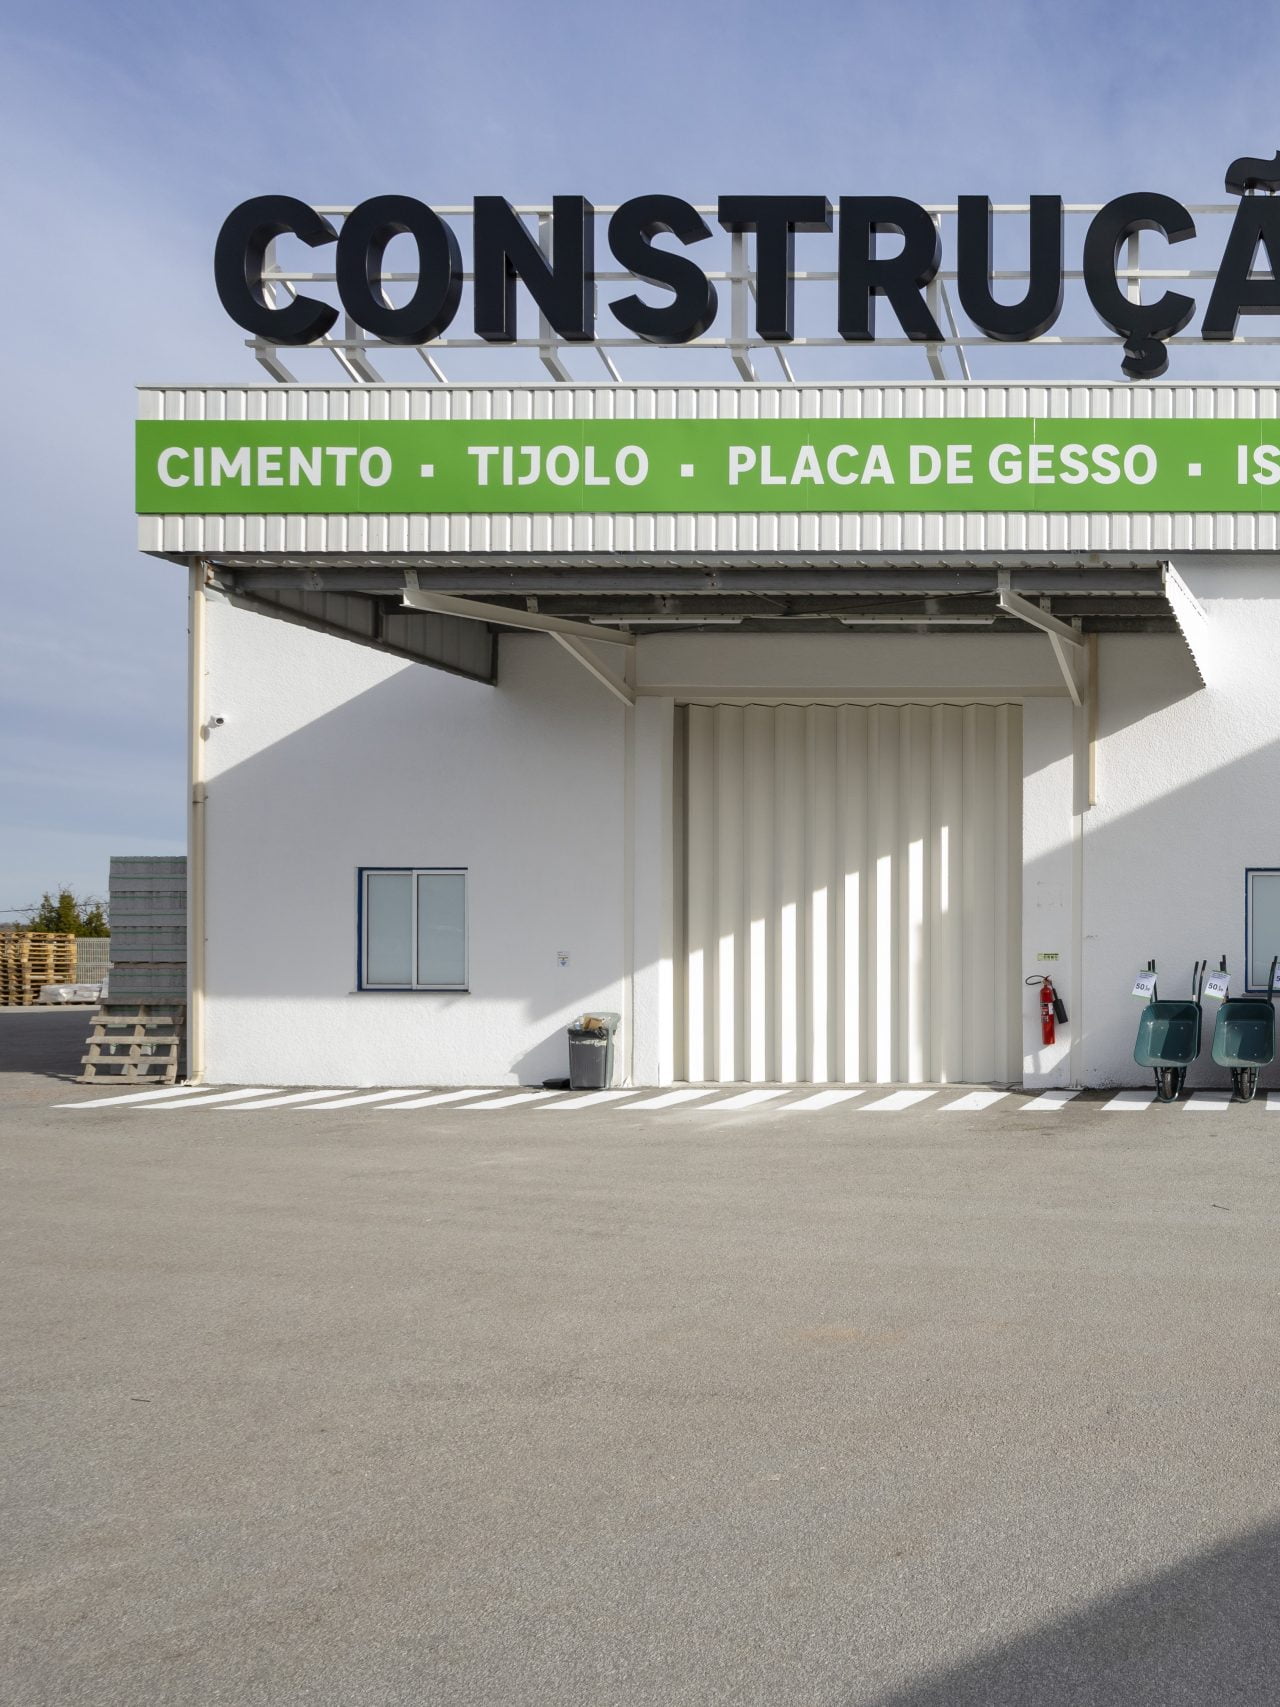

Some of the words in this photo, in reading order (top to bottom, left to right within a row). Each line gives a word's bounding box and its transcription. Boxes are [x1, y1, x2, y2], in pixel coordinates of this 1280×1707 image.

[157, 446, 393, 488] CIMENTO
[467, 445, 650, 487] TIJOLO
[728, 444, 896, 487] PLACA
[909, 444, 975, 485] DE
[988, 443, 1159, 486] GESSO
